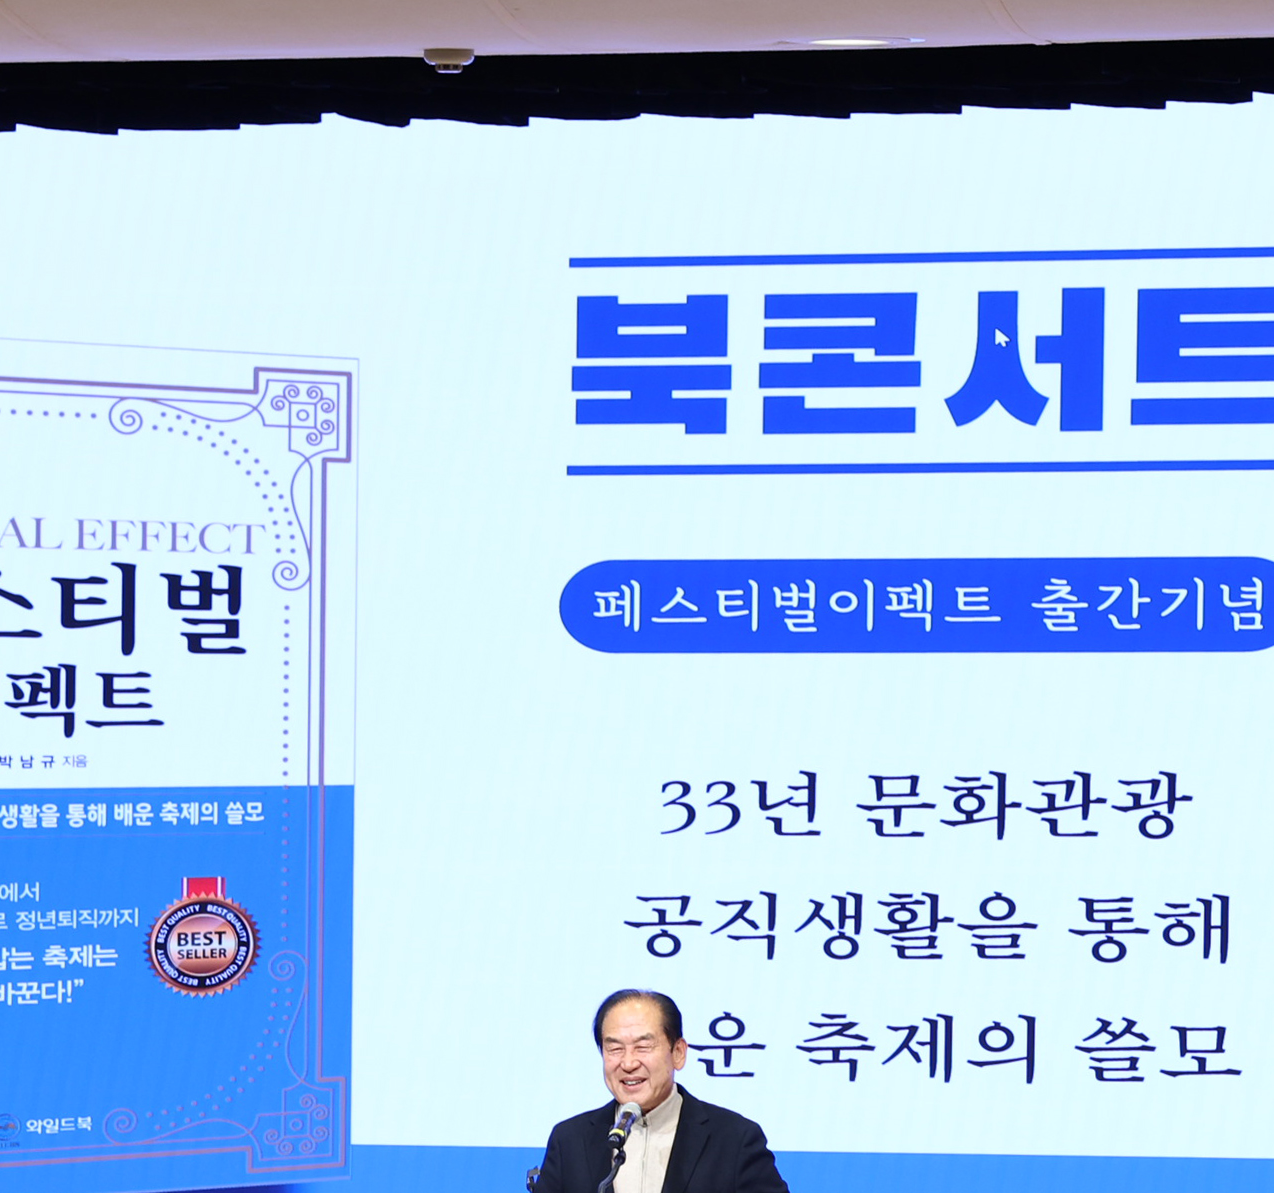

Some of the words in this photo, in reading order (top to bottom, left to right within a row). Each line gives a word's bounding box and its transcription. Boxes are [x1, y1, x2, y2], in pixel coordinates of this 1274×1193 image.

[75, 519, 267, 556] EFFECT
[594, 579, 1001, 632] 페스티벌이펙트
[1032, 577, 1263, 631] 출간기념
[62, 754, 88, 768] 지음
[65, 803, 107, 828] 통해
[114, 802, 154, 826] 배운
[159, 801, 219, 826] 축제의
[224, 801, 265, 825] 쓸모
[661, 771, 821, 836] 33년
[857, 771, 1193, 840] 문화관광
[15, 907, 139, 932] 정년퇴직까지
[157, 925, 170, 943] BEST
[167, 904, 200, 926] QUALITY
[207, 904, 228, 916] BEST
[226, 911, 247, 942] QUALITY
[624, 891, 1037, 960] 공직생활을
[1068, 894, 1229, 964] 통해
[177, 931, 227, 946] BEST
[42, 944, 119, 969] 축제는
[157, 949, 179, 978] QUALITY
[177, 948, 227, 960] SELLER
[236, 946, 247, 966] BEST
[177, 976, 198, 986] BEST
[205, 964, 238, 986] QUALITY
[686, 1012, 766, 1078] 운
[796, 1014, 1035, 1084] 축제의
[1075, 1017, 1241, 1081] 쓸모
[26, 1116, 92, 1135] 와일드북
